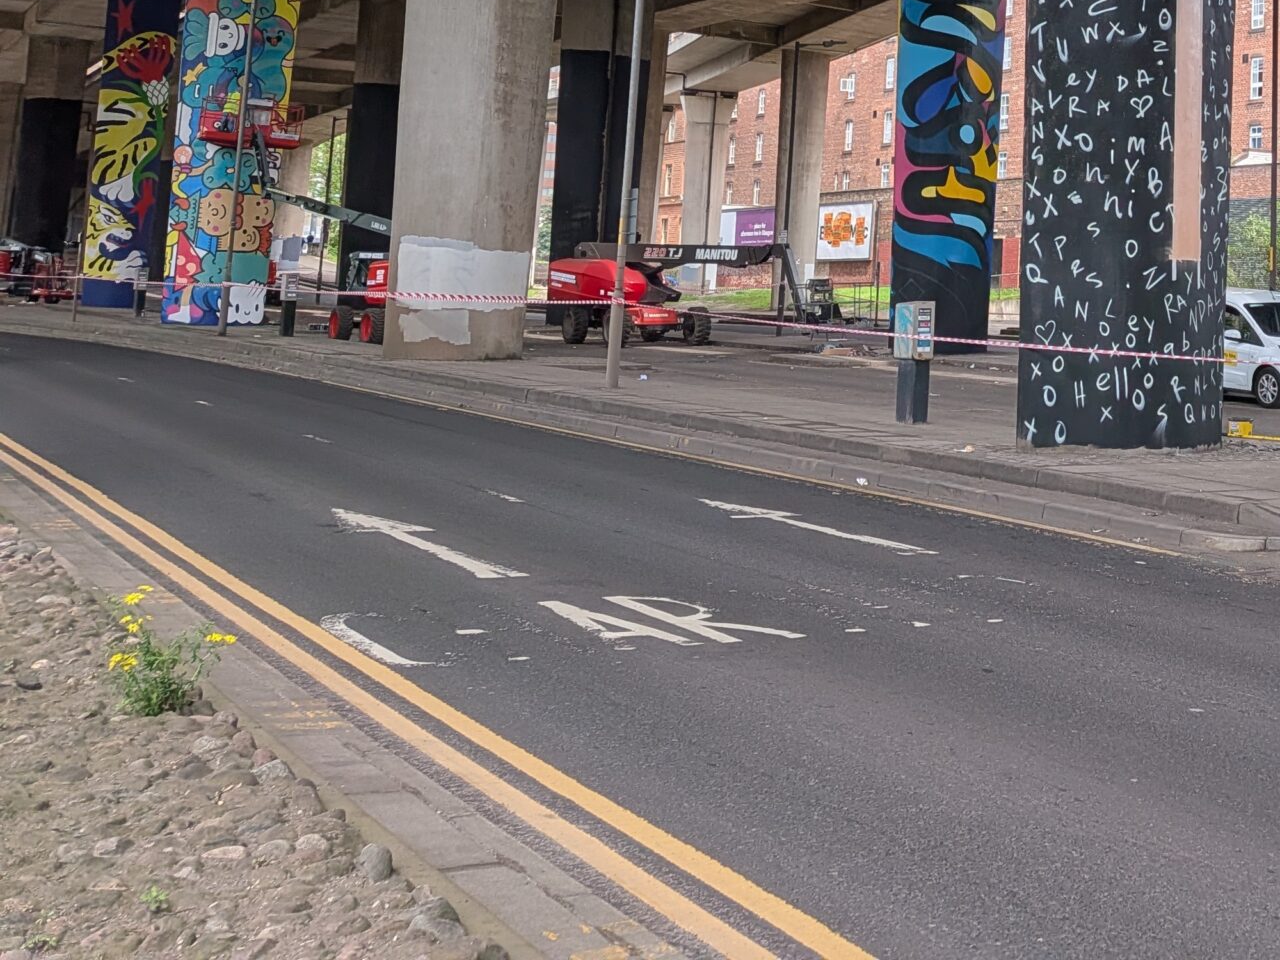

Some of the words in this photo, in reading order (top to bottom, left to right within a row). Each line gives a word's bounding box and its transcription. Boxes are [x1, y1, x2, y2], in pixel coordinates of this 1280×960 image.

[643, 247, 666, 257] 220
[668, 248, 682, 258] TJ
[695, 248, 738, 260] MANITOU
